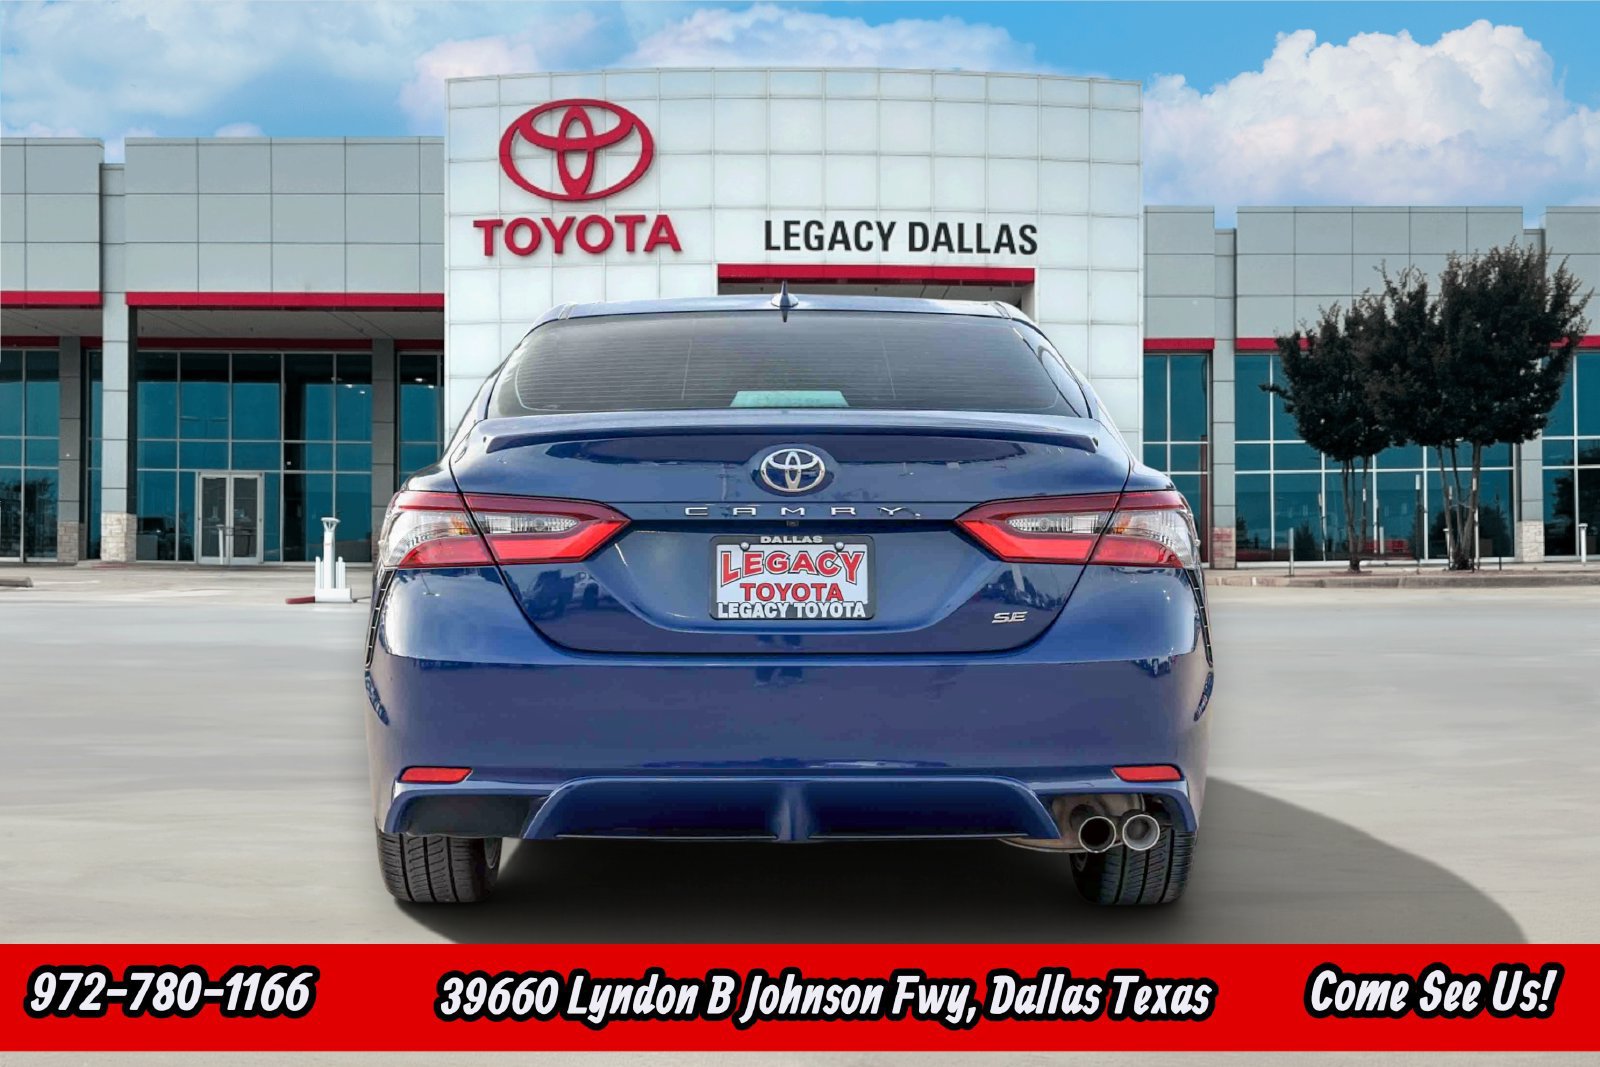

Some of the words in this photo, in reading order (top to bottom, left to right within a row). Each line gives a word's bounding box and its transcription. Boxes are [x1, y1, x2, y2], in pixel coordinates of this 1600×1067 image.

[473, 213, 682, 257] TOYOTA
[764, 220, 897, 252] LEGACY
[907, 222, 1039, 255] DALLAS
[684, 506, 907, 517] CAMRY
[760, 535, 823, 544] DALLAS
[720, 550, 866, 587] LEGACY
[739, 582, 844, 602] TOYOTA
[717, 601, 789, 619] LEGACY
[793, 601, 866, 619] TOYOTA
[991, 611, 1028, 624] SE
